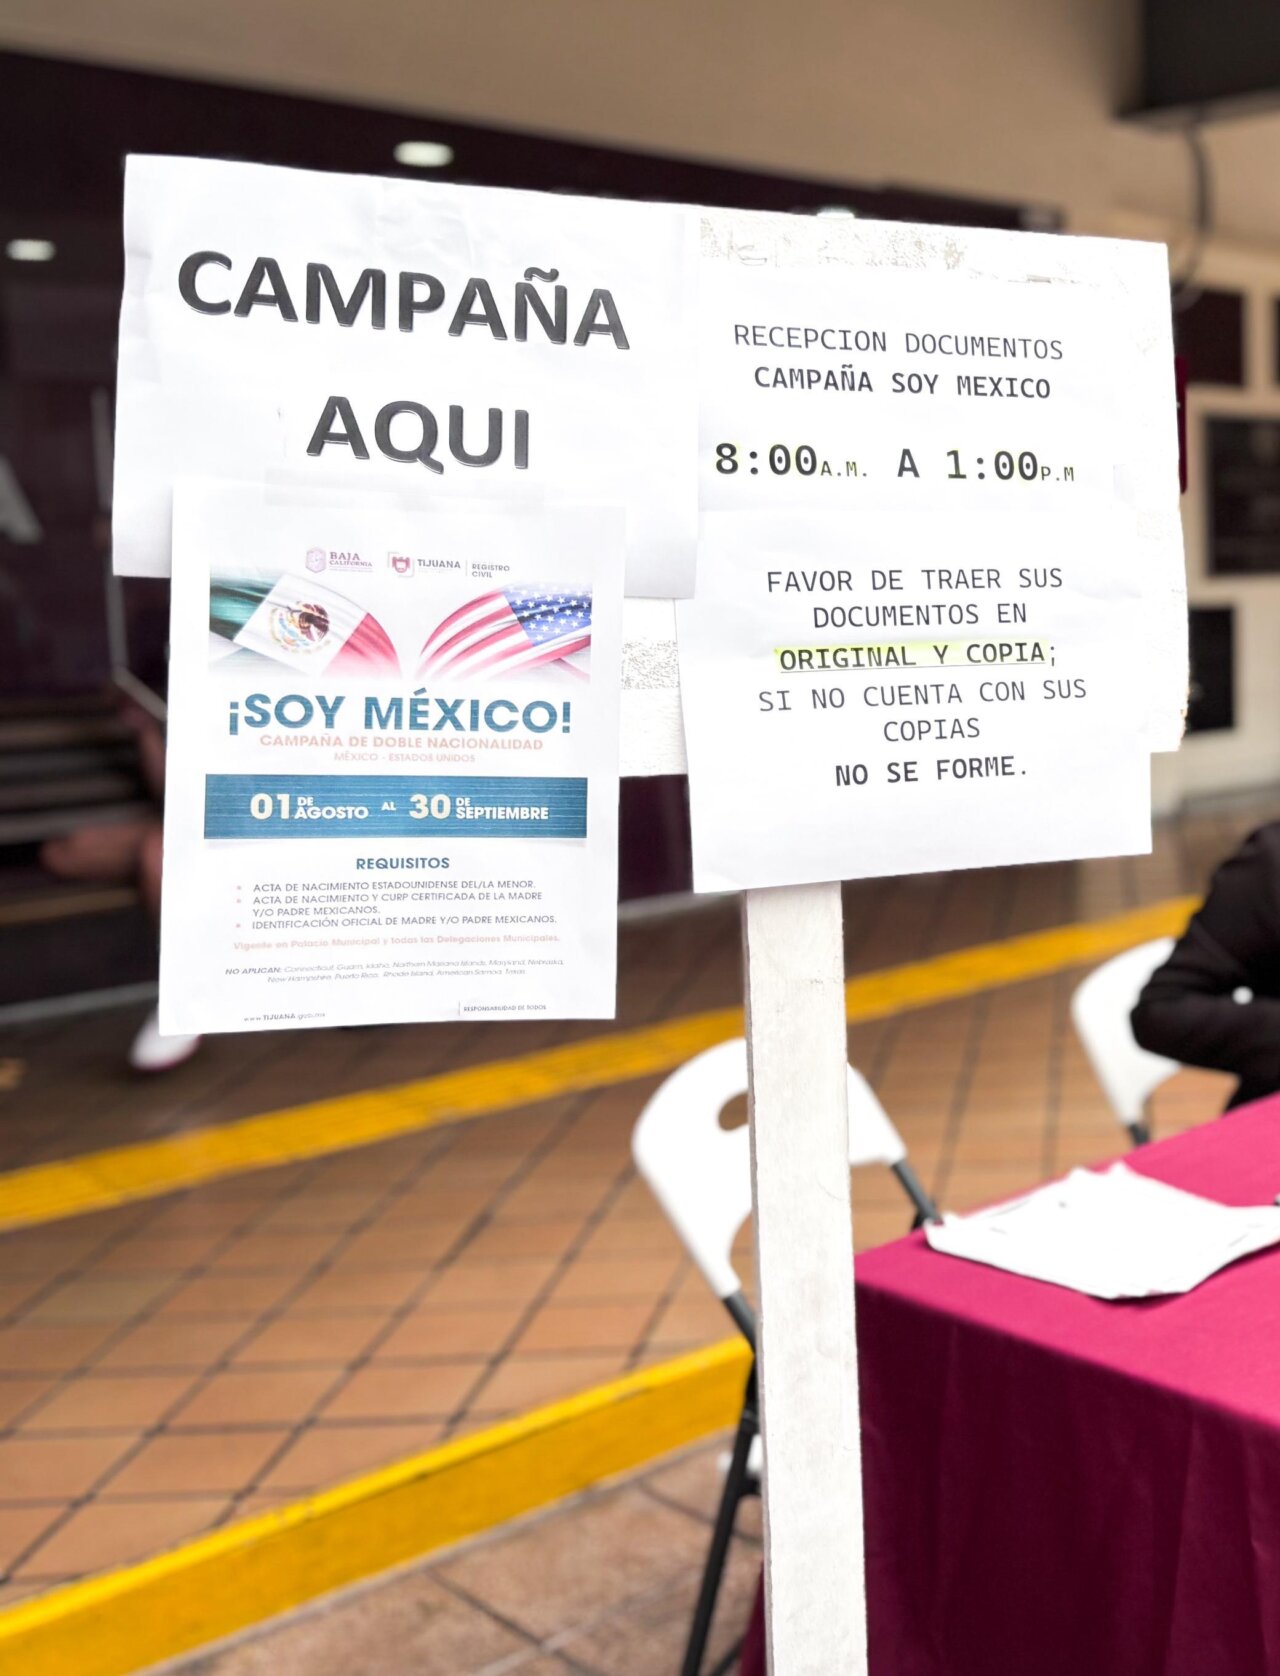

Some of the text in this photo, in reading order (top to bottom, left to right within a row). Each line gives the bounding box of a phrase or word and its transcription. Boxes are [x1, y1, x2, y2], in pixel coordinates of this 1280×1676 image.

[178, 250, 630, 350] CAMPAÑA
[734, 324, 1063, 360] RECEPCION DOCUMENTOS
[754, 363, 1051, 399] CAMPAÑA SOY MEXICO
[306, 395, 530, 475] AQUI
[897, 448, 920, 478] A
[330, 551, 360, 560] BAJA
[417, 558, 461, 569] TIJUANA
[472, 564, 510, 572] REGISTRO
[767, 567, 1063, 593] FAVOR DE TRAER SUS
[813, 602, 1027, 629] DOCUMENTOS EN
[780, 641, 1055, 671] ORIGINAL Y COPIA;
[759, 678, 1086, 712] SI NO CUENTA CON SUS
[228, 687, 571, 735] ¡SOY MÉXICO!
[260, 732, 544, 751] CAMPAÑA DE DOBLE NACIONALIDAD
[883, 717, 980, 742] COPIAS
[334, 751, 378, 762] MÉXICO
[389, 753, 434, 763] ESTADOS
[437, 753, 476, 764] UNIDOS
[835, 755, 1026, 787] NO SE FORME.
[250, 793, 549, 820] 01 DE AGOSTO AL 30 DE SEPTIEMBRE
[356, 857, 450, 870] REQUISITOS
[253, 880, 536, 892] ACTA DE NACIMIENTO ESTADOUNIDENSE DEL/LA MENOR.
[253, 892, 542, 905] ACTA DE NACIMIENTO Y CURP CERTIFICADA DE LA MADRE
[252, 915, 557, 930] IDENTIFICACIÓN OFICIAL DE MADRE Y/O PADRE MEXICANOS.
[253, 906, 381, 917] Y/O PADRE MEXICANOS.
[234, 934, 560, 951] Vigente en Palacio Municipal y todas las Delegaciones Municipales.
